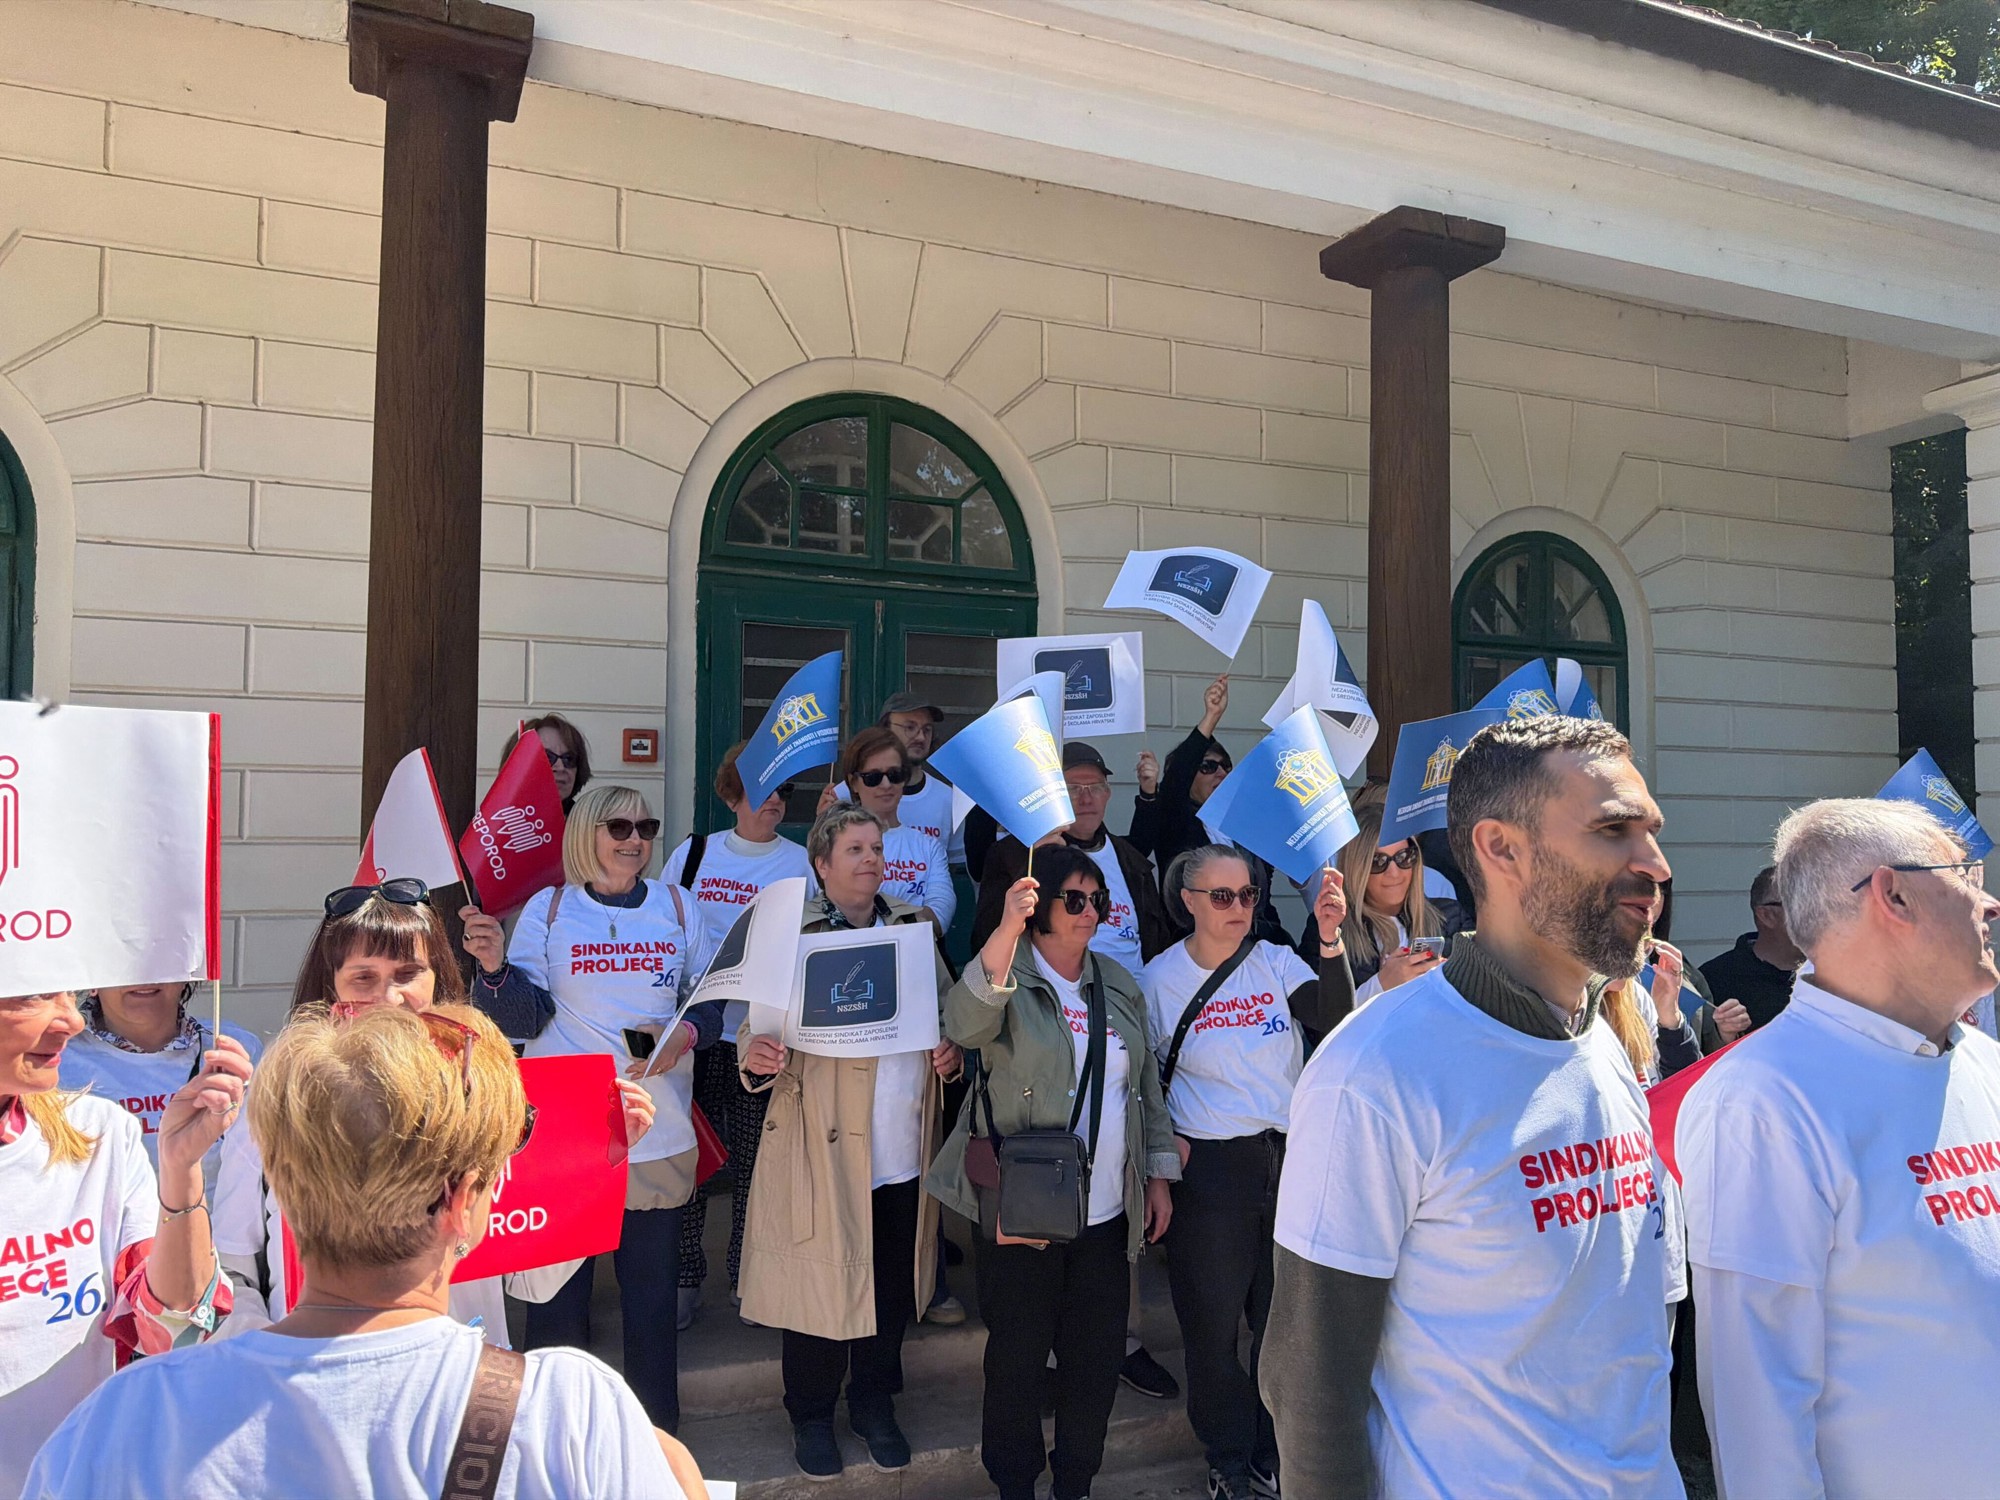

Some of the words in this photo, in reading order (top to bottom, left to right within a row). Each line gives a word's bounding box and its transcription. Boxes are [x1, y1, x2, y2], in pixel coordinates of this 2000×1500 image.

[1285, 822, 1312, 847] NEZAVISNI
[571, 941, 677, 958] SINDIKALNO
[571, 954, 664, 975] PROLJEĆE
[836, 1001, 869, 1013] NSZSŠH
[798, 1031, 833, 1039] NEZAVISNI
[834, 1030, 863, 1038] SINDIKAT
[863, 1025, 899, 1036] ZAPOSLENIH
[804, 1036, 838, 1045] SREDNJIM
[838, 1035, 869, 1045] ŠKOLAMA
[869, 1032, 899, 1041] HRVATSKE
[1531, 1166, 1658, 1233] PROLJEĆE
